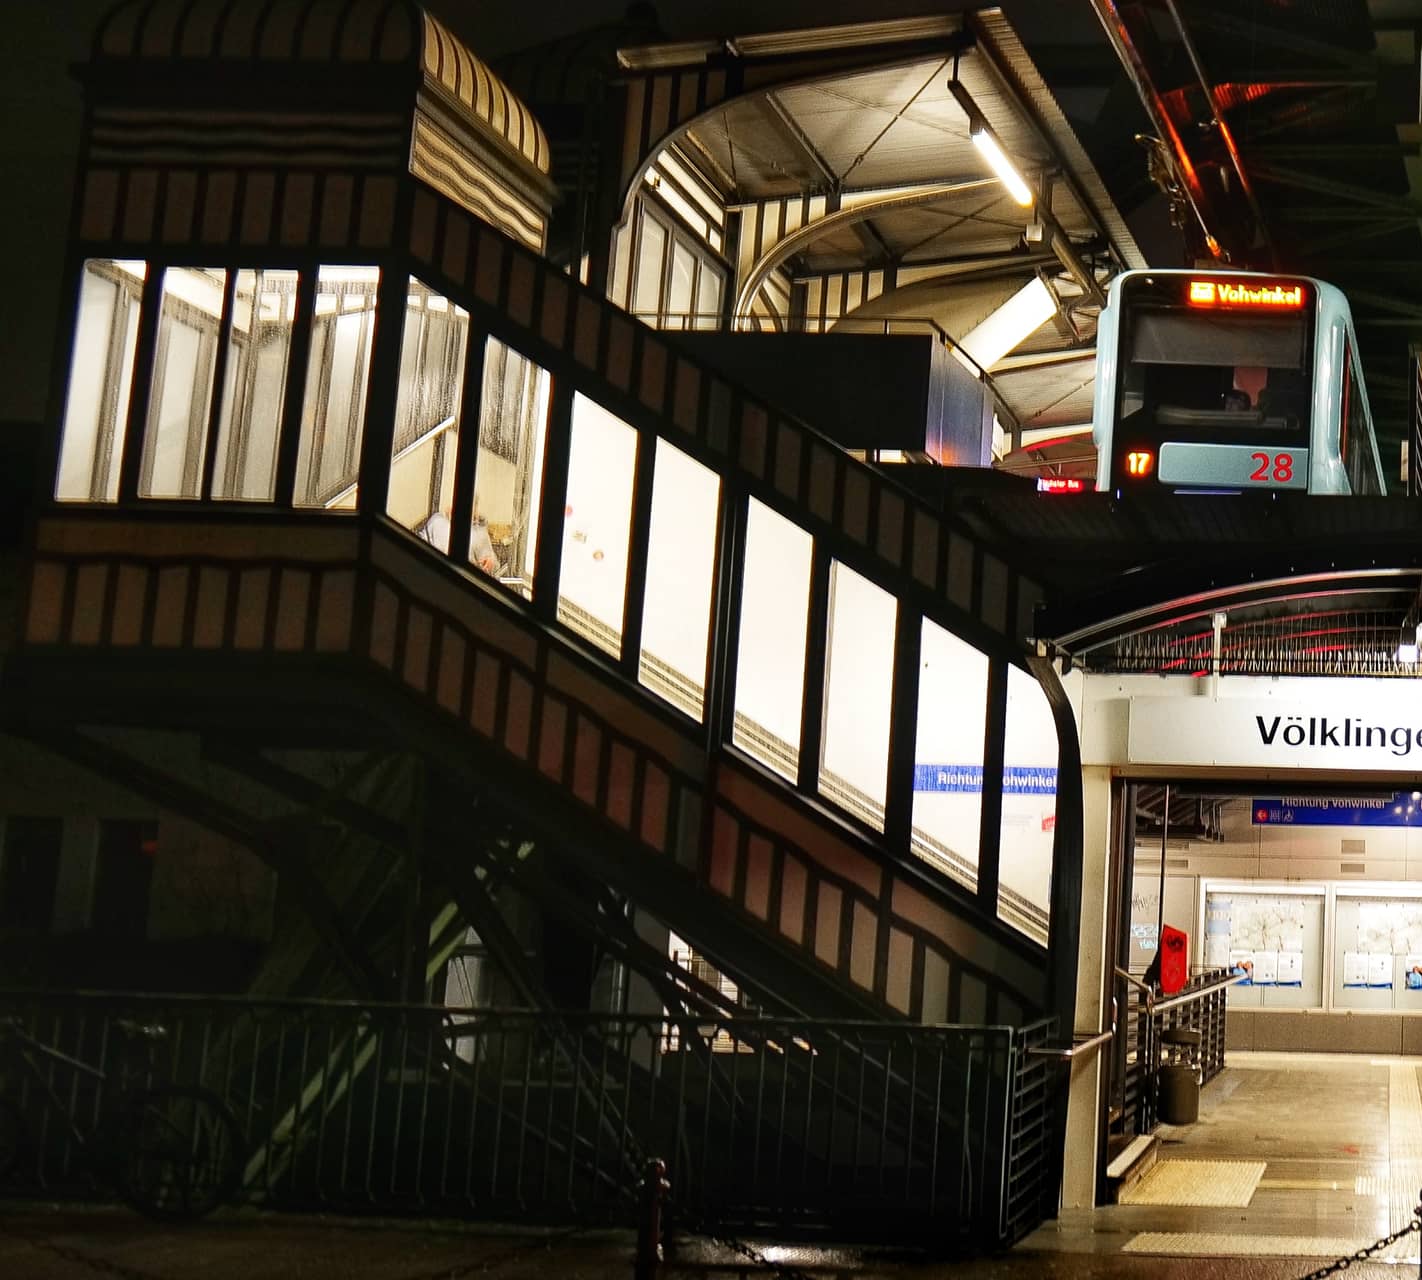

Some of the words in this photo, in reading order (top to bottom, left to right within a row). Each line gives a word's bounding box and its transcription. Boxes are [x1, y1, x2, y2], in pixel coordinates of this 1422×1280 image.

[1217, 282, 1301, 305] Vohwinkel
[1128, 452, 1150, 474] 17
[1250, 452, 1293, 482] 28
[938, 771, 983, 785] Richtun
[1003, 774, 1057, 787] ohwinkel
